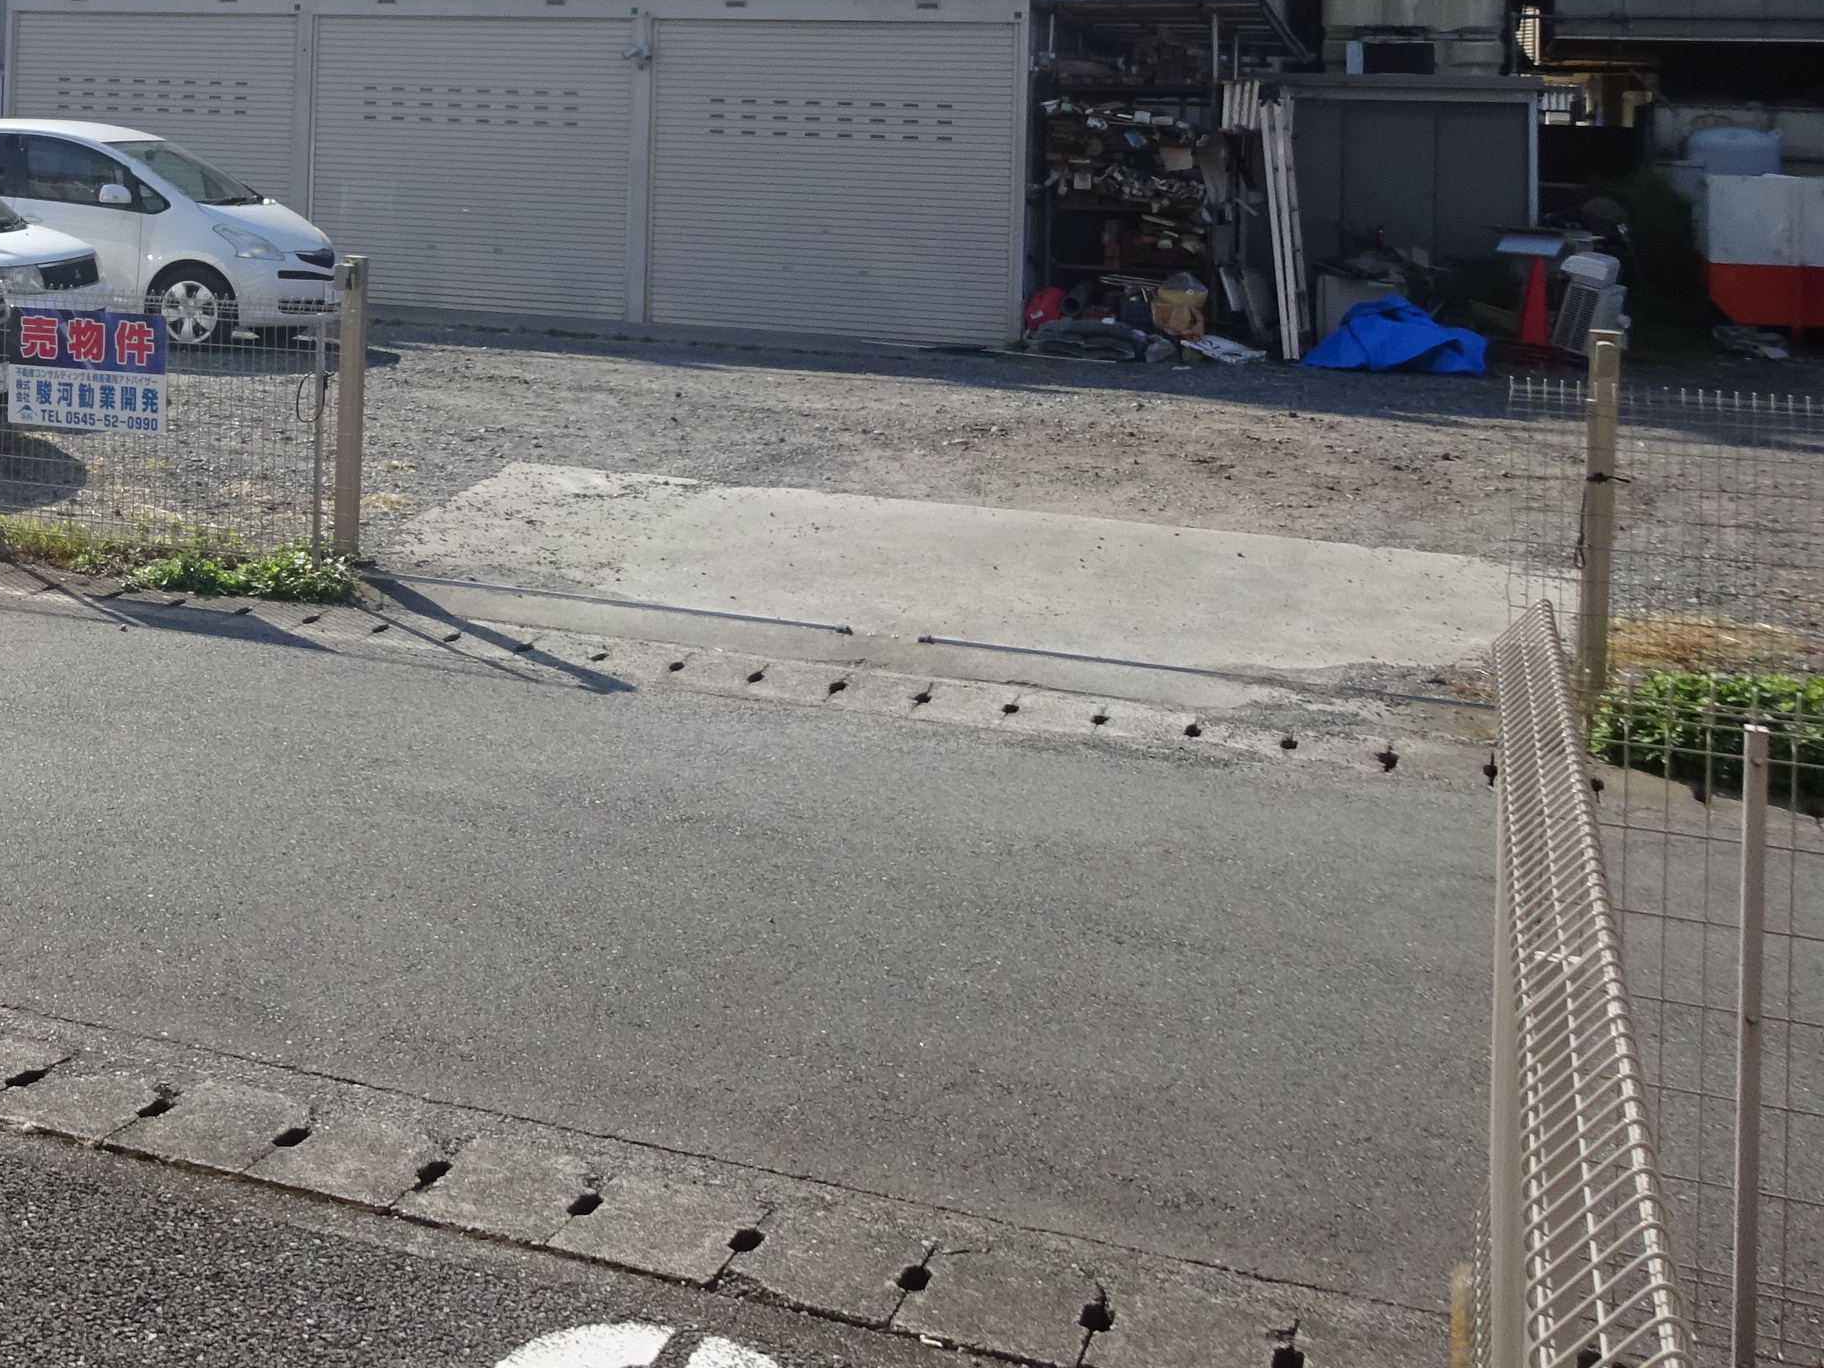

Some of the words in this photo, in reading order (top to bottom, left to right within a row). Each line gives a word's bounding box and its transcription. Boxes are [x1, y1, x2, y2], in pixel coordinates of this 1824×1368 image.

[21, 315, 154, 365] 売物件
[37, 380, 158, 414] 駿河勧業開発
[40, 409, 61, 423] TEL
[65, 411, 158, 431] 0545-52-0990
